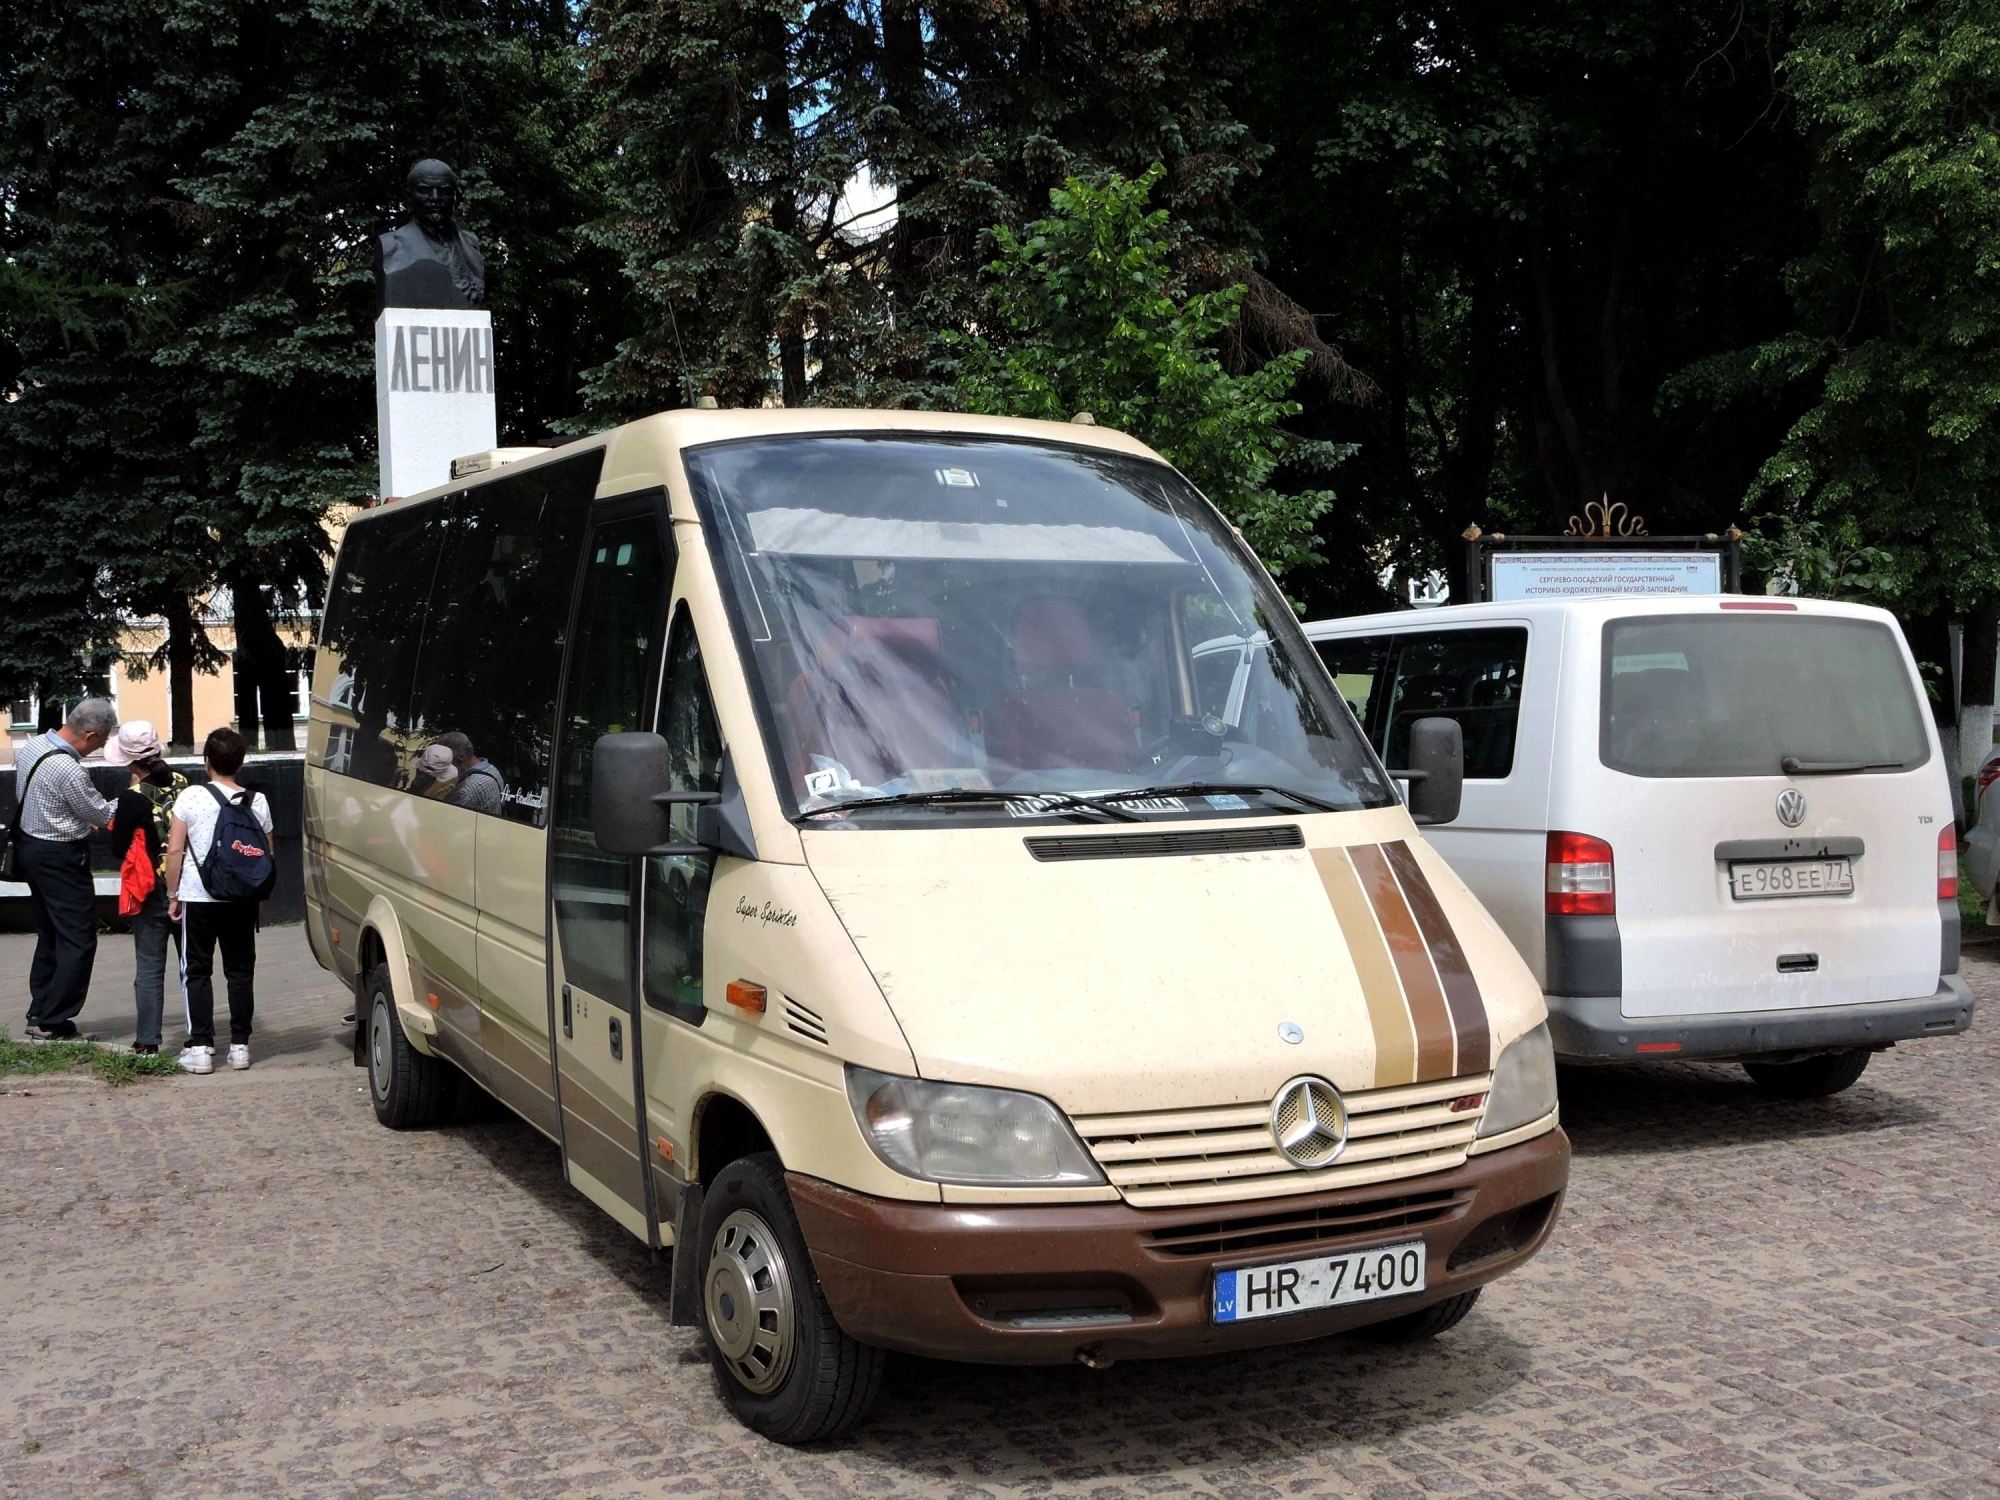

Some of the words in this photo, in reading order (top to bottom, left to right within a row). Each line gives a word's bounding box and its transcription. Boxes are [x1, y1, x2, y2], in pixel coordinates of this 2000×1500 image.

[390, 326, 493, 393] ЛЕНИН
[1539, 575, 1612, 584] СЕРГИЕВО-ПОСАДСКИЙ
[1614, 575, 1675, 583] ГОСУДАРСТВЕННЫЙ
[1525, 585, 1622, 594] ИСТОРИКО-ХУДОЖЕСТВЕННЫЙ
[1623, 585, 1688, 593] МУЗЕЙ-ЗАПОВЕДНИК
[736, 895, 758, 922] Super
[760, 901, 798, 928] Sprinter
[1218, 1300, 1234, 1314] LV
